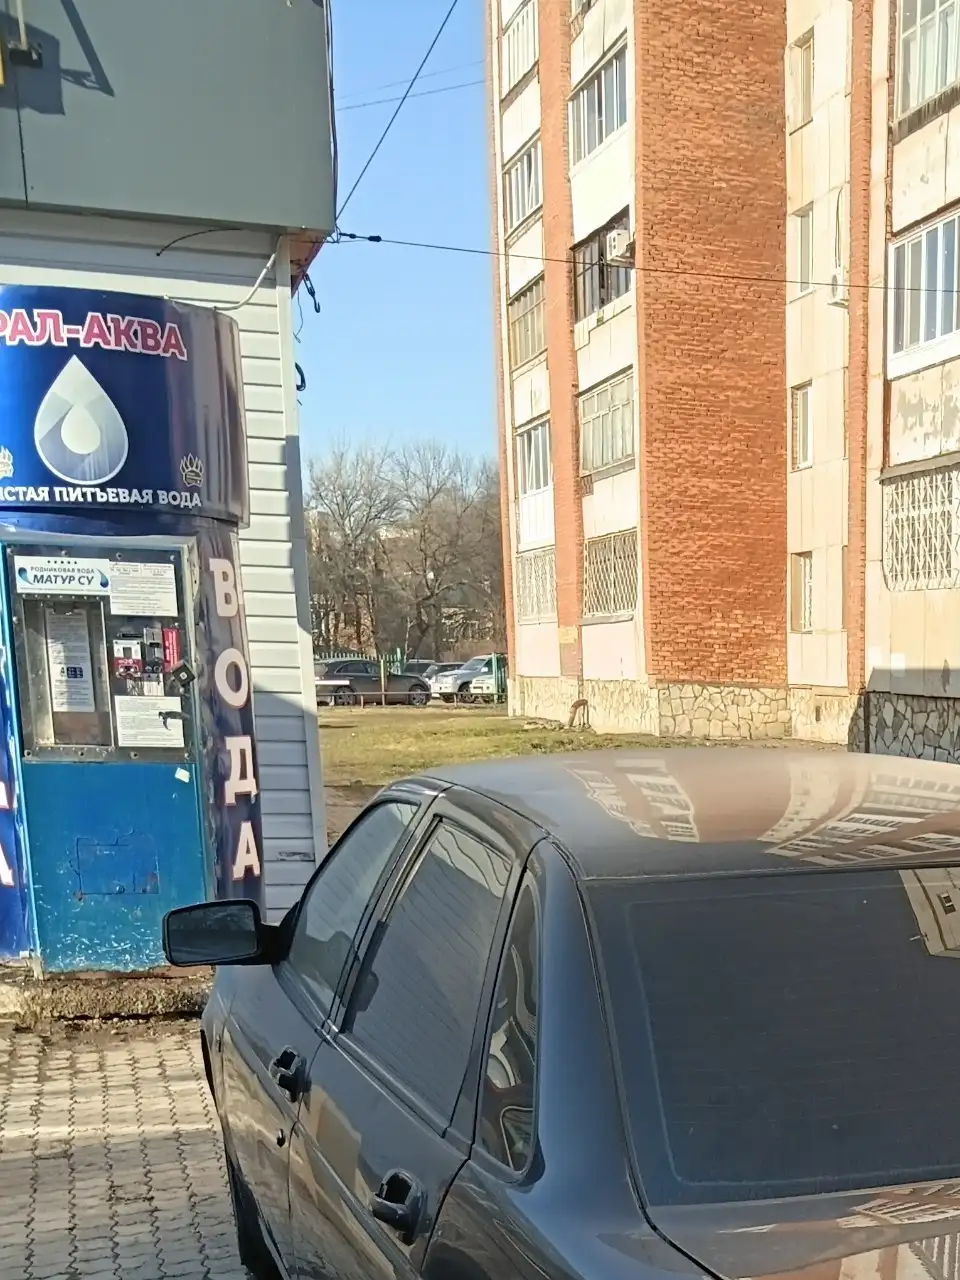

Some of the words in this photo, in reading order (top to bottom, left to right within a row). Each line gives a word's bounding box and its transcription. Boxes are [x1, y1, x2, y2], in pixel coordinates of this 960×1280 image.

[53, 486, 153, 504] ПИТЬЕВАЯ
[157, 489, 202, 509] ВОДА
[32, 574, 76, 585] МАТУР
[77, 575, 95, 586] СУ
[209, 557, 261, 881] ВОДА
